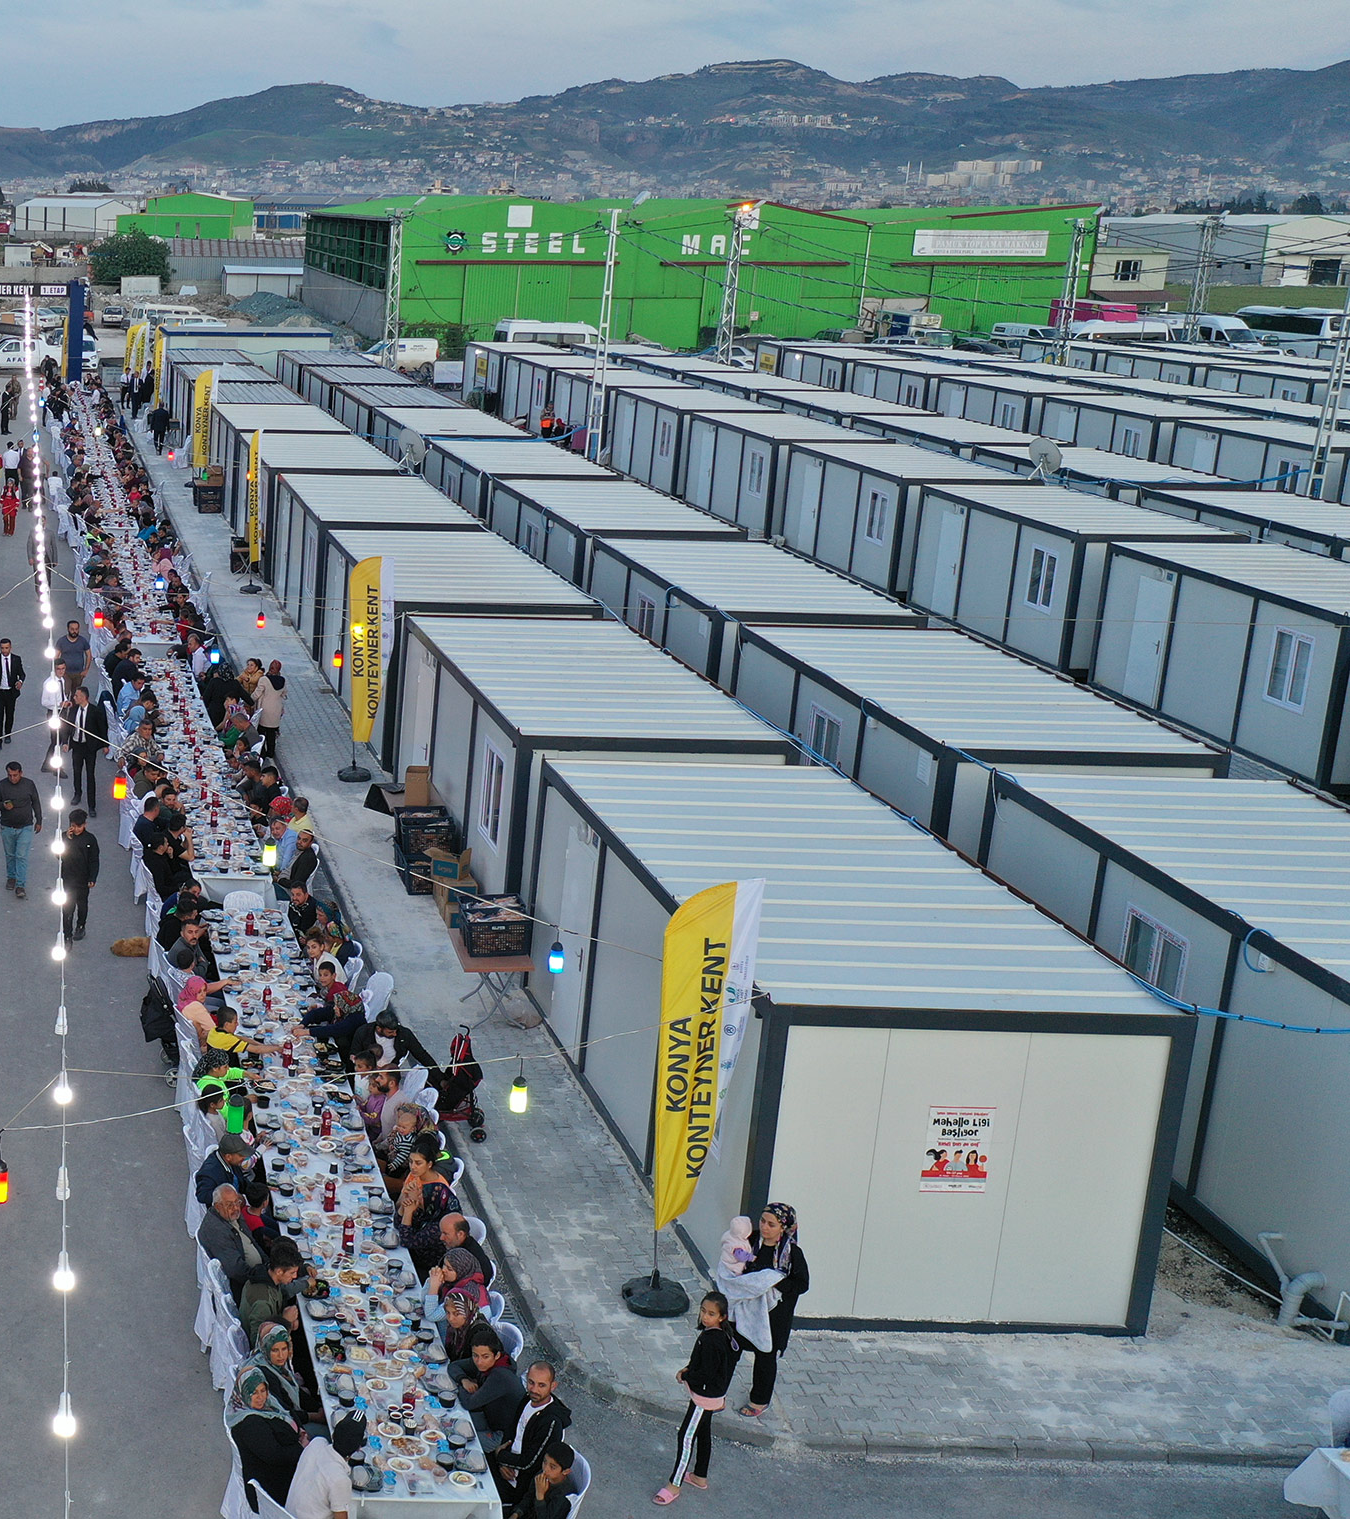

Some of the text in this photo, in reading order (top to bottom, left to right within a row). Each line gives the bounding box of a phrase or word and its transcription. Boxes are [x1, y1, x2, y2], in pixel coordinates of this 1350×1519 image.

[481, 232, 585, 253] STEEL
[965, 240, 1003, 248] TOPLAMA
[13, 285, 34, 295] KENT
[367, 585, 379, 719] KONTEYNER KENT
[665, 1016, 693, 1113] KONYA
[686, 937, 727, 1179] KONTEYNER KENT
[942, 1128, 979, 1138] Başlıyor
